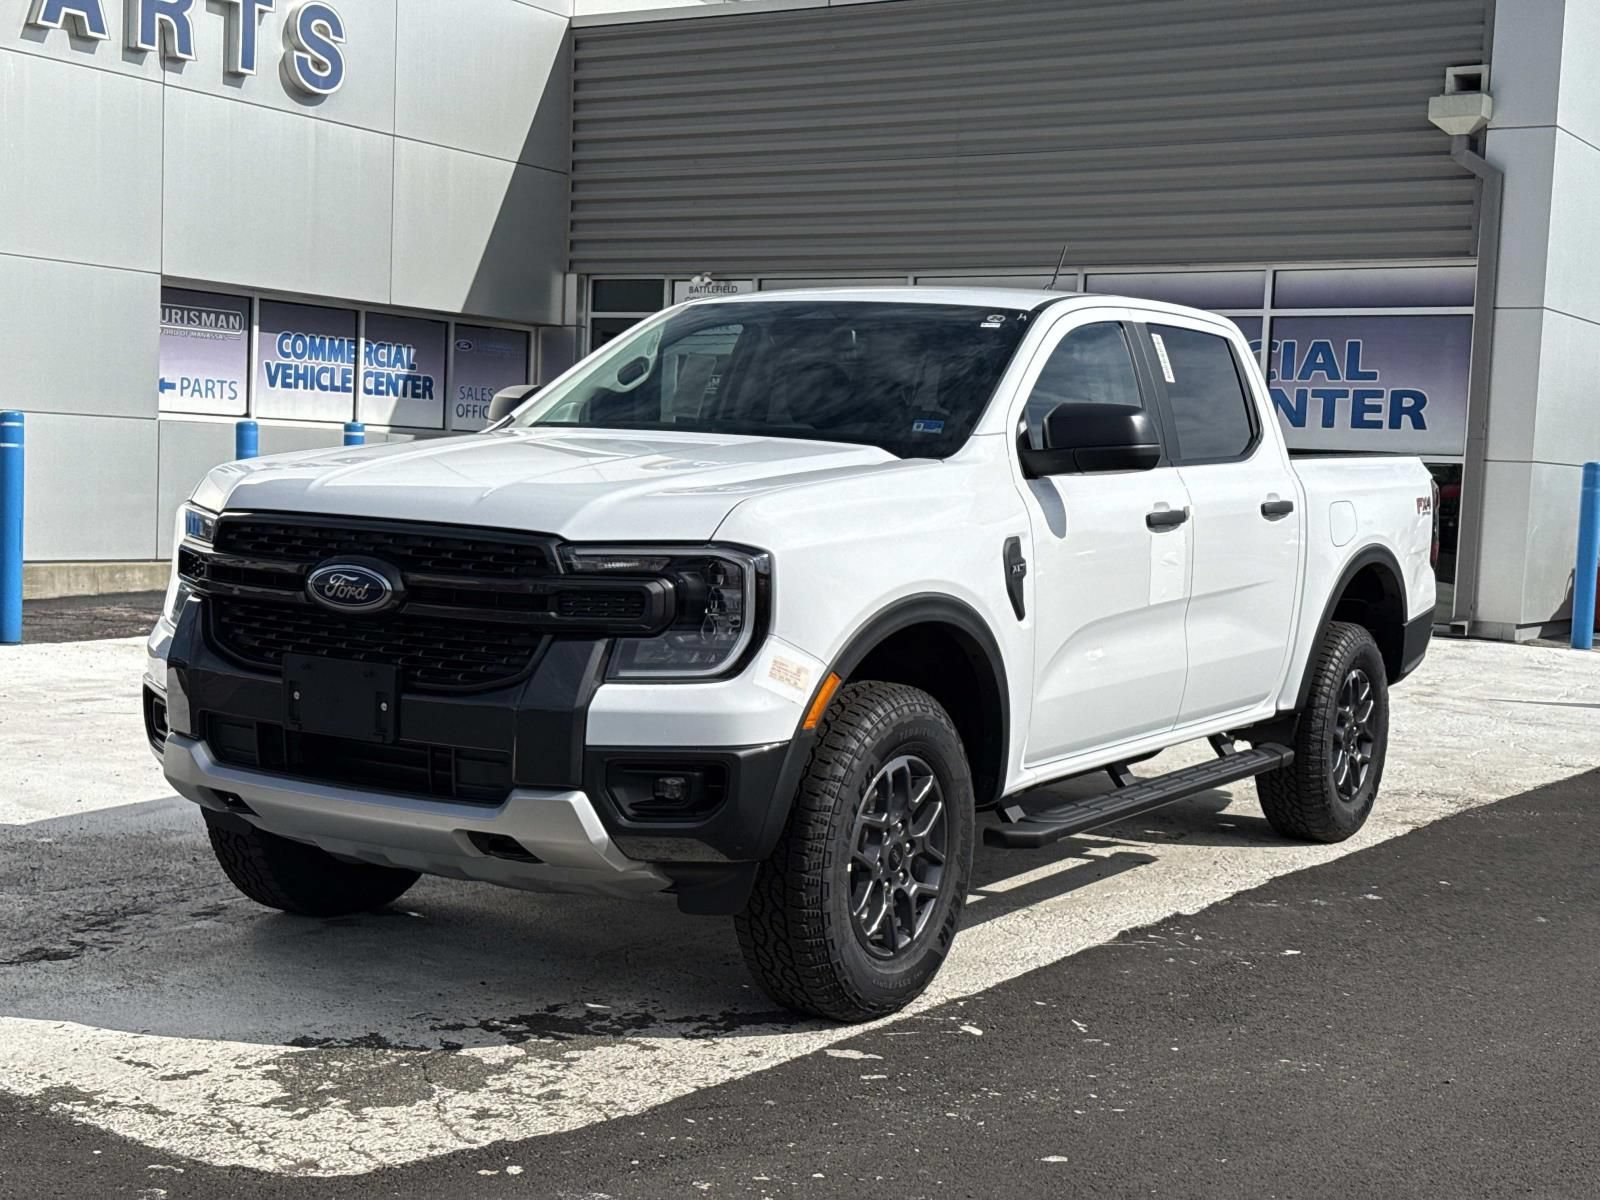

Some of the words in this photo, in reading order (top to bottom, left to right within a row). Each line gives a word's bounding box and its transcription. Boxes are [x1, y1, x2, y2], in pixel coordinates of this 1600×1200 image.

[689, 285, 738, 294] BATTLEFIELD
[276, 331, 417, 370] COMMERCIAL
[180, 377, 238, 400] PARTS
[264, 361, 353, 393] VEHICLE
[363, 370, 434, 401] CENTER
[459, 386, 494, 402] SALES
[1416, 496, 1431, 514] FX4
[324, 573, 370, 601] Ford
